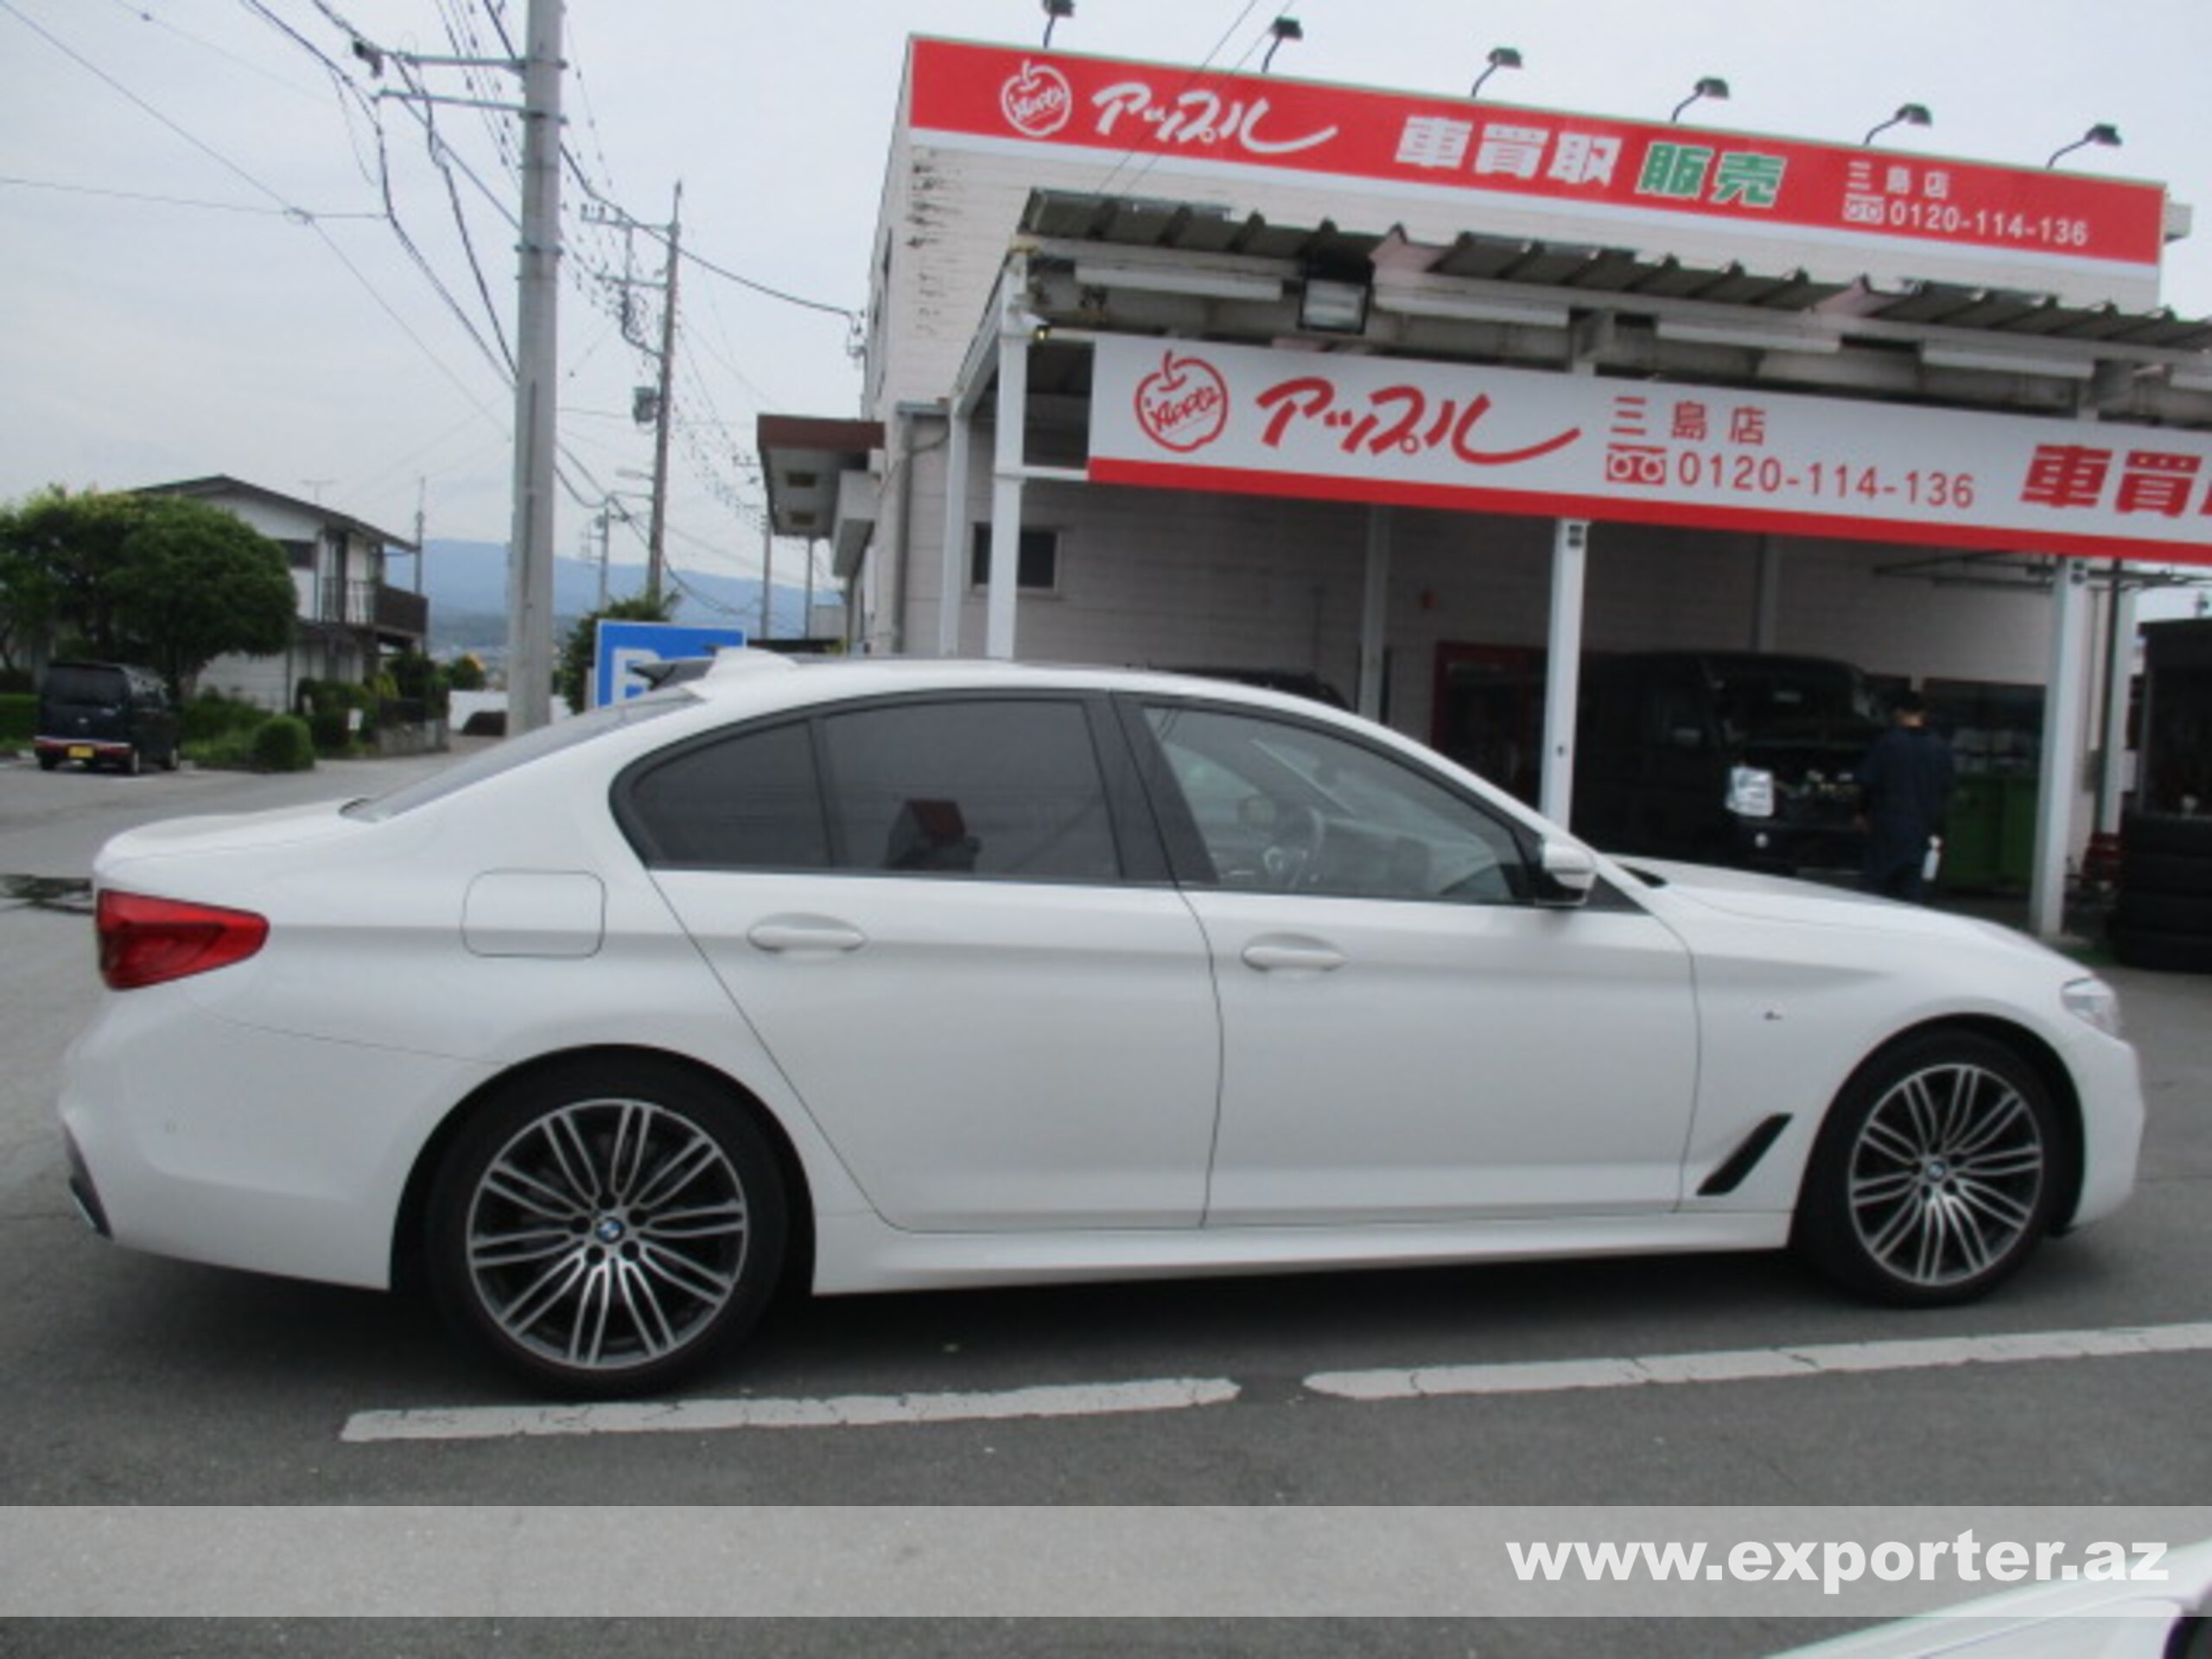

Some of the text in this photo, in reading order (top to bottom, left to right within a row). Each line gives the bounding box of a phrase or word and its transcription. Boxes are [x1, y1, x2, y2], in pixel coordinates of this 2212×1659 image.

[1092, 82, 1338, 153] アップル
[1635, 140, 1788, 207] 販売
[1889, 200, 2088, 245] 0120-114-136
[1256, 376, 1581, 466] アップル
[1611, 396, 1766, 445] 三島店
[1678, 450, 1976, 508] 0120-114-136
[2018, 443, 2212, 518] 車買
